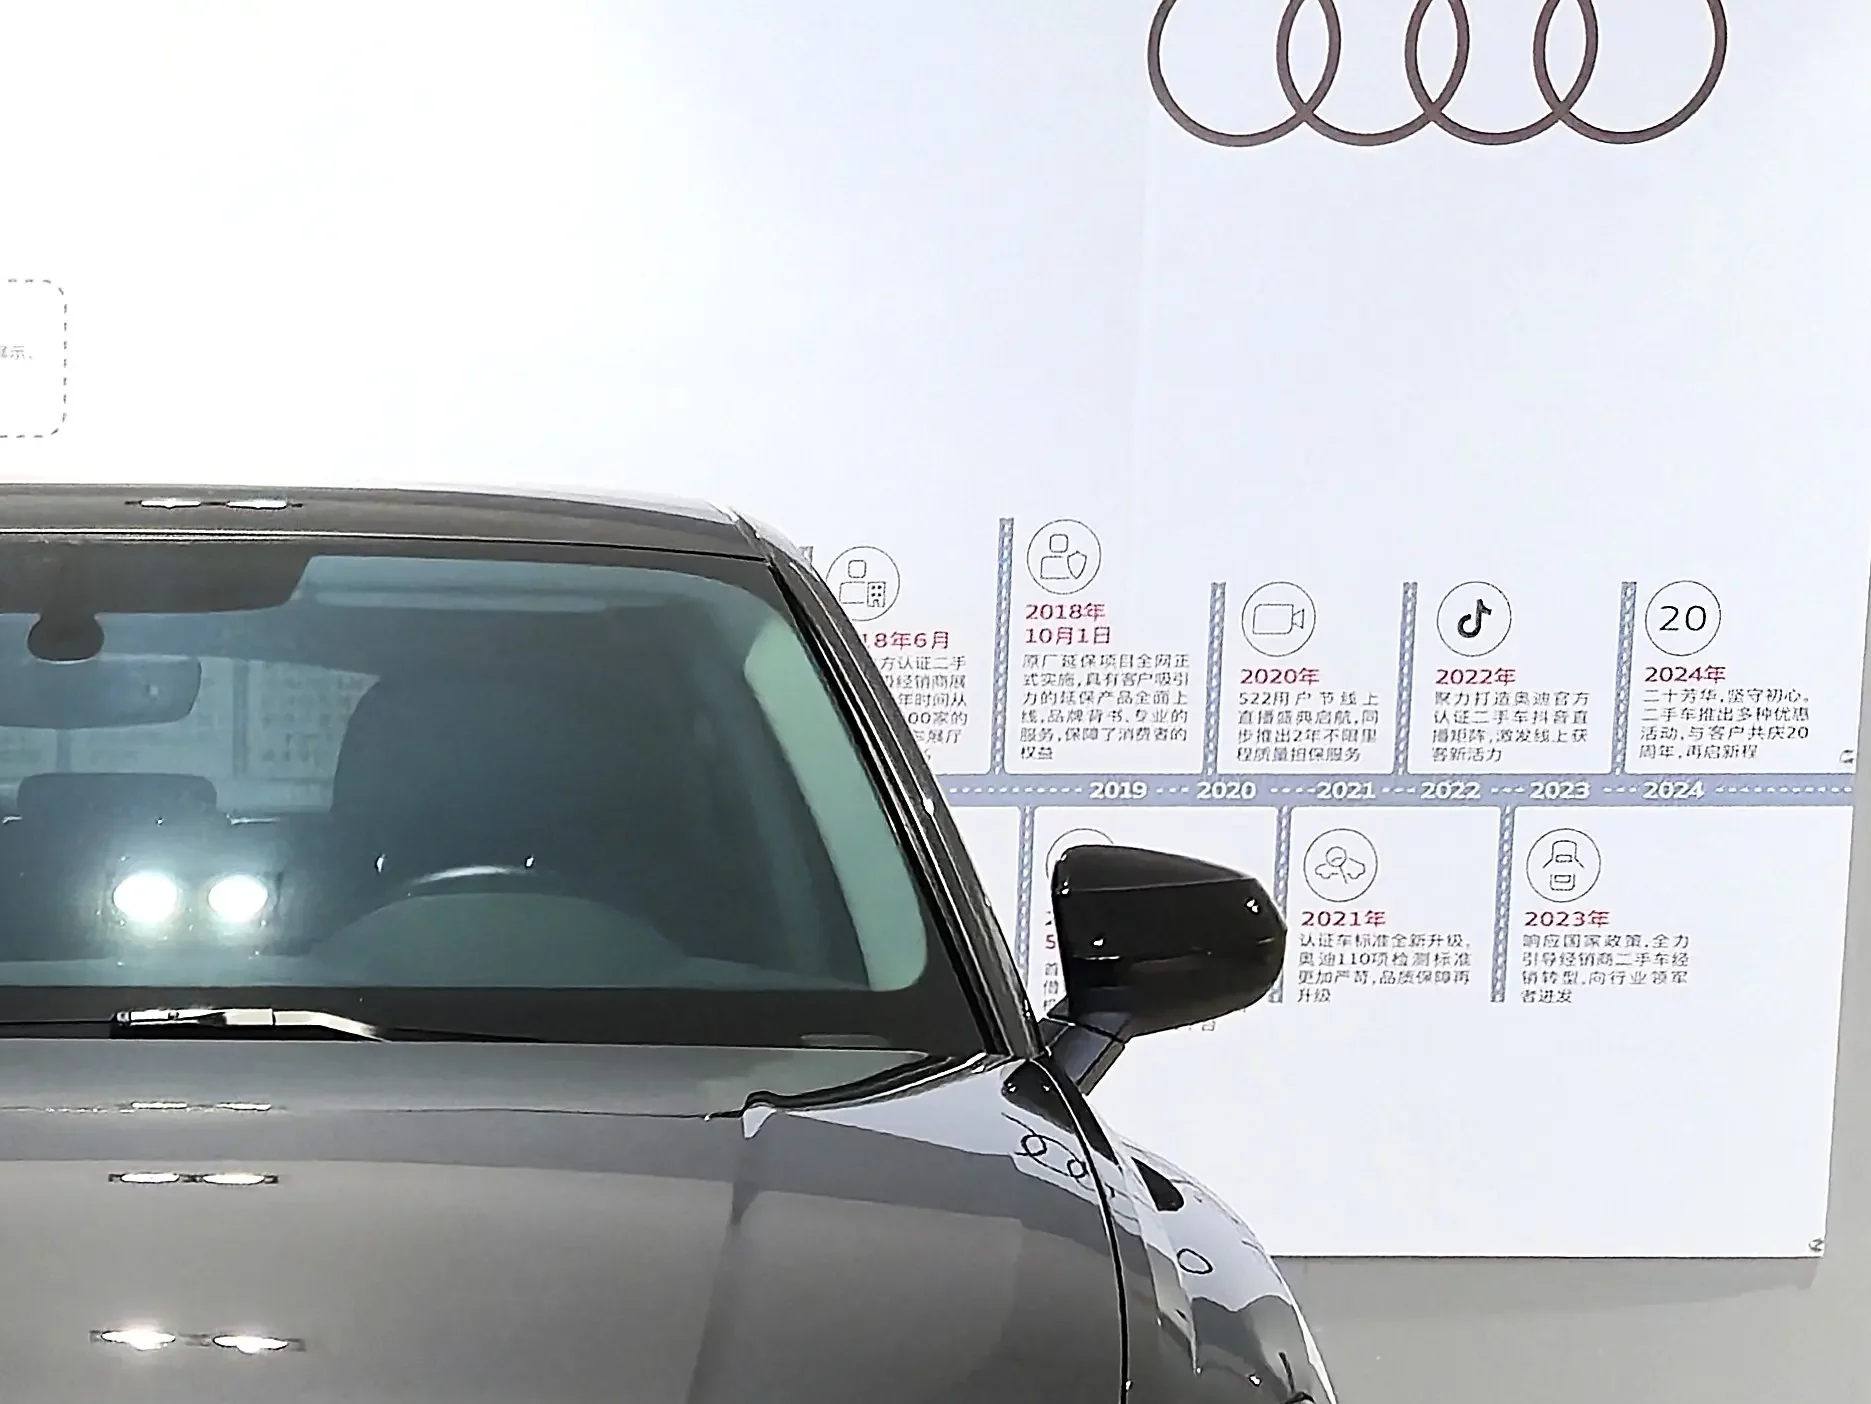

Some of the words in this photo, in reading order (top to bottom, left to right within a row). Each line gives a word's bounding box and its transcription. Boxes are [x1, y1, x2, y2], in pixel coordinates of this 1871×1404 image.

[1026, 602, 1105, 621] 2018年
[1659, 606, 1707, 632] 20
[1026, 625, 1111, 646] 10月1日
[1022, 653, 1190, 669] 原厂延保项目全网正
[1240, 667, 1320, 685] 2020年
[1436, 667, 1516, 685] 2022年
[1643, 665, 1726, 683] 2024年
[1021, 690, 1188, 706] 力的延保产品全面上
[1434, 710, 1588, 726] 认证二手车抖音直
[1641, 706, 1809, 722] 二手车推出多种优惠
[1020, 746, 1054, 761] 权益
[1431, 746, 1502, 762] 客新活力
[1089, 781, 1148, 800] 2019
[1197, 781, 1257, 800] 2020
[1317, 781, 1376, 800] 2021
[1420, 781, 1481, 800] 2022
[1530, 781, 1591, 799] 2023
[1643, 781, 1704, 799] 2024
[1301, 909, 1386, 928] 2021年
[1524, 909, 1611, 928] 2023年
[1522, 951, 1689, 967] 引导经销商二手车经
[1297, 988, 1331, 1003] 升级
[1520, 989, 1572, 1004] 者进发
